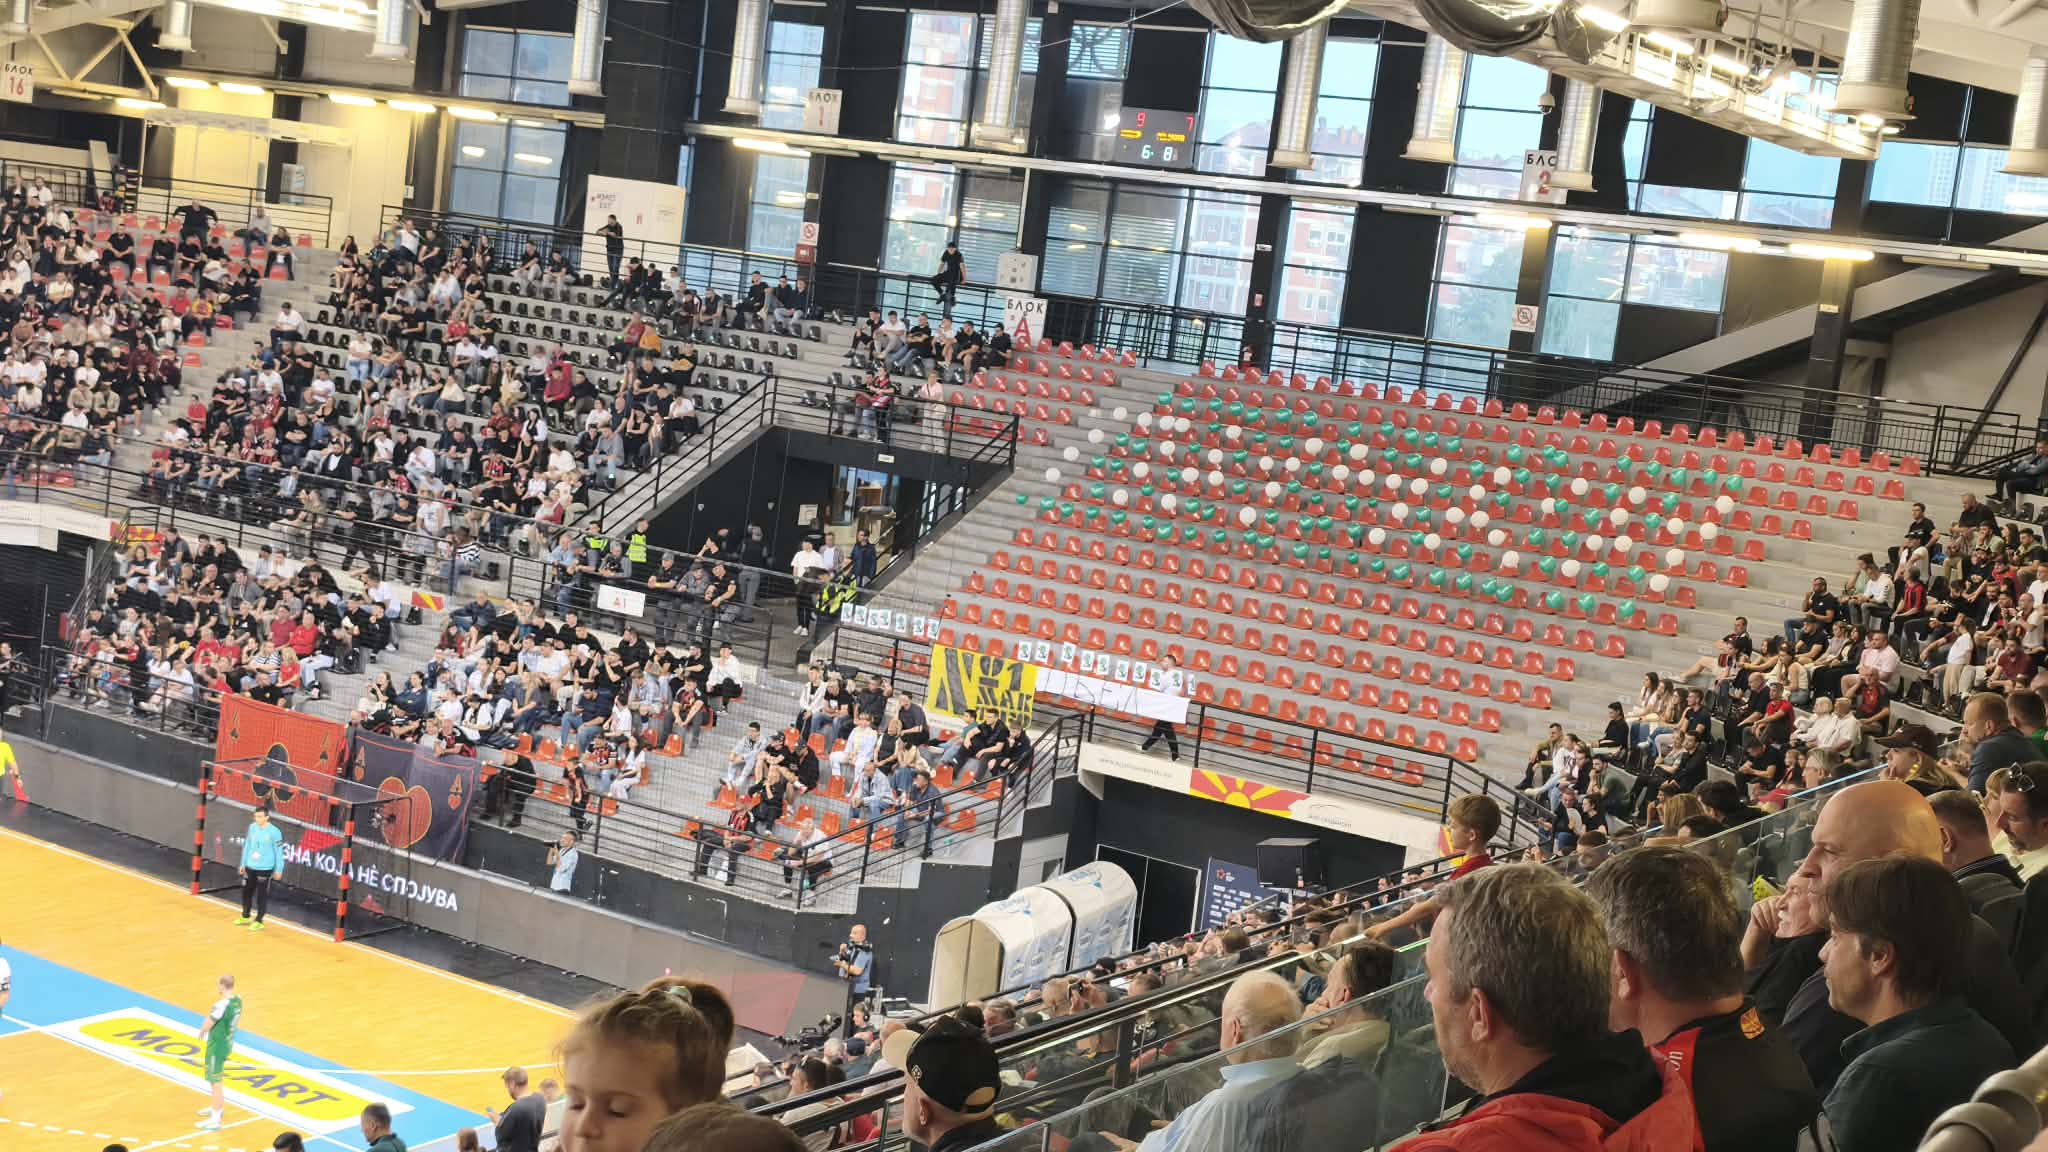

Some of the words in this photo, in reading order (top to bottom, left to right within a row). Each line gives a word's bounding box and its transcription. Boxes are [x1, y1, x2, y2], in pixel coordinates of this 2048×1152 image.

[10, 76, 24, 96] 16
[1137, 112, 1147, 128] 9
[1186, 115, 1194, 132] 7
[1538, 170, 1552, 195] 2
[1007, 298, 1043, 313] БЛОК
[381, 872, 458, 913] СПОЈУВА
